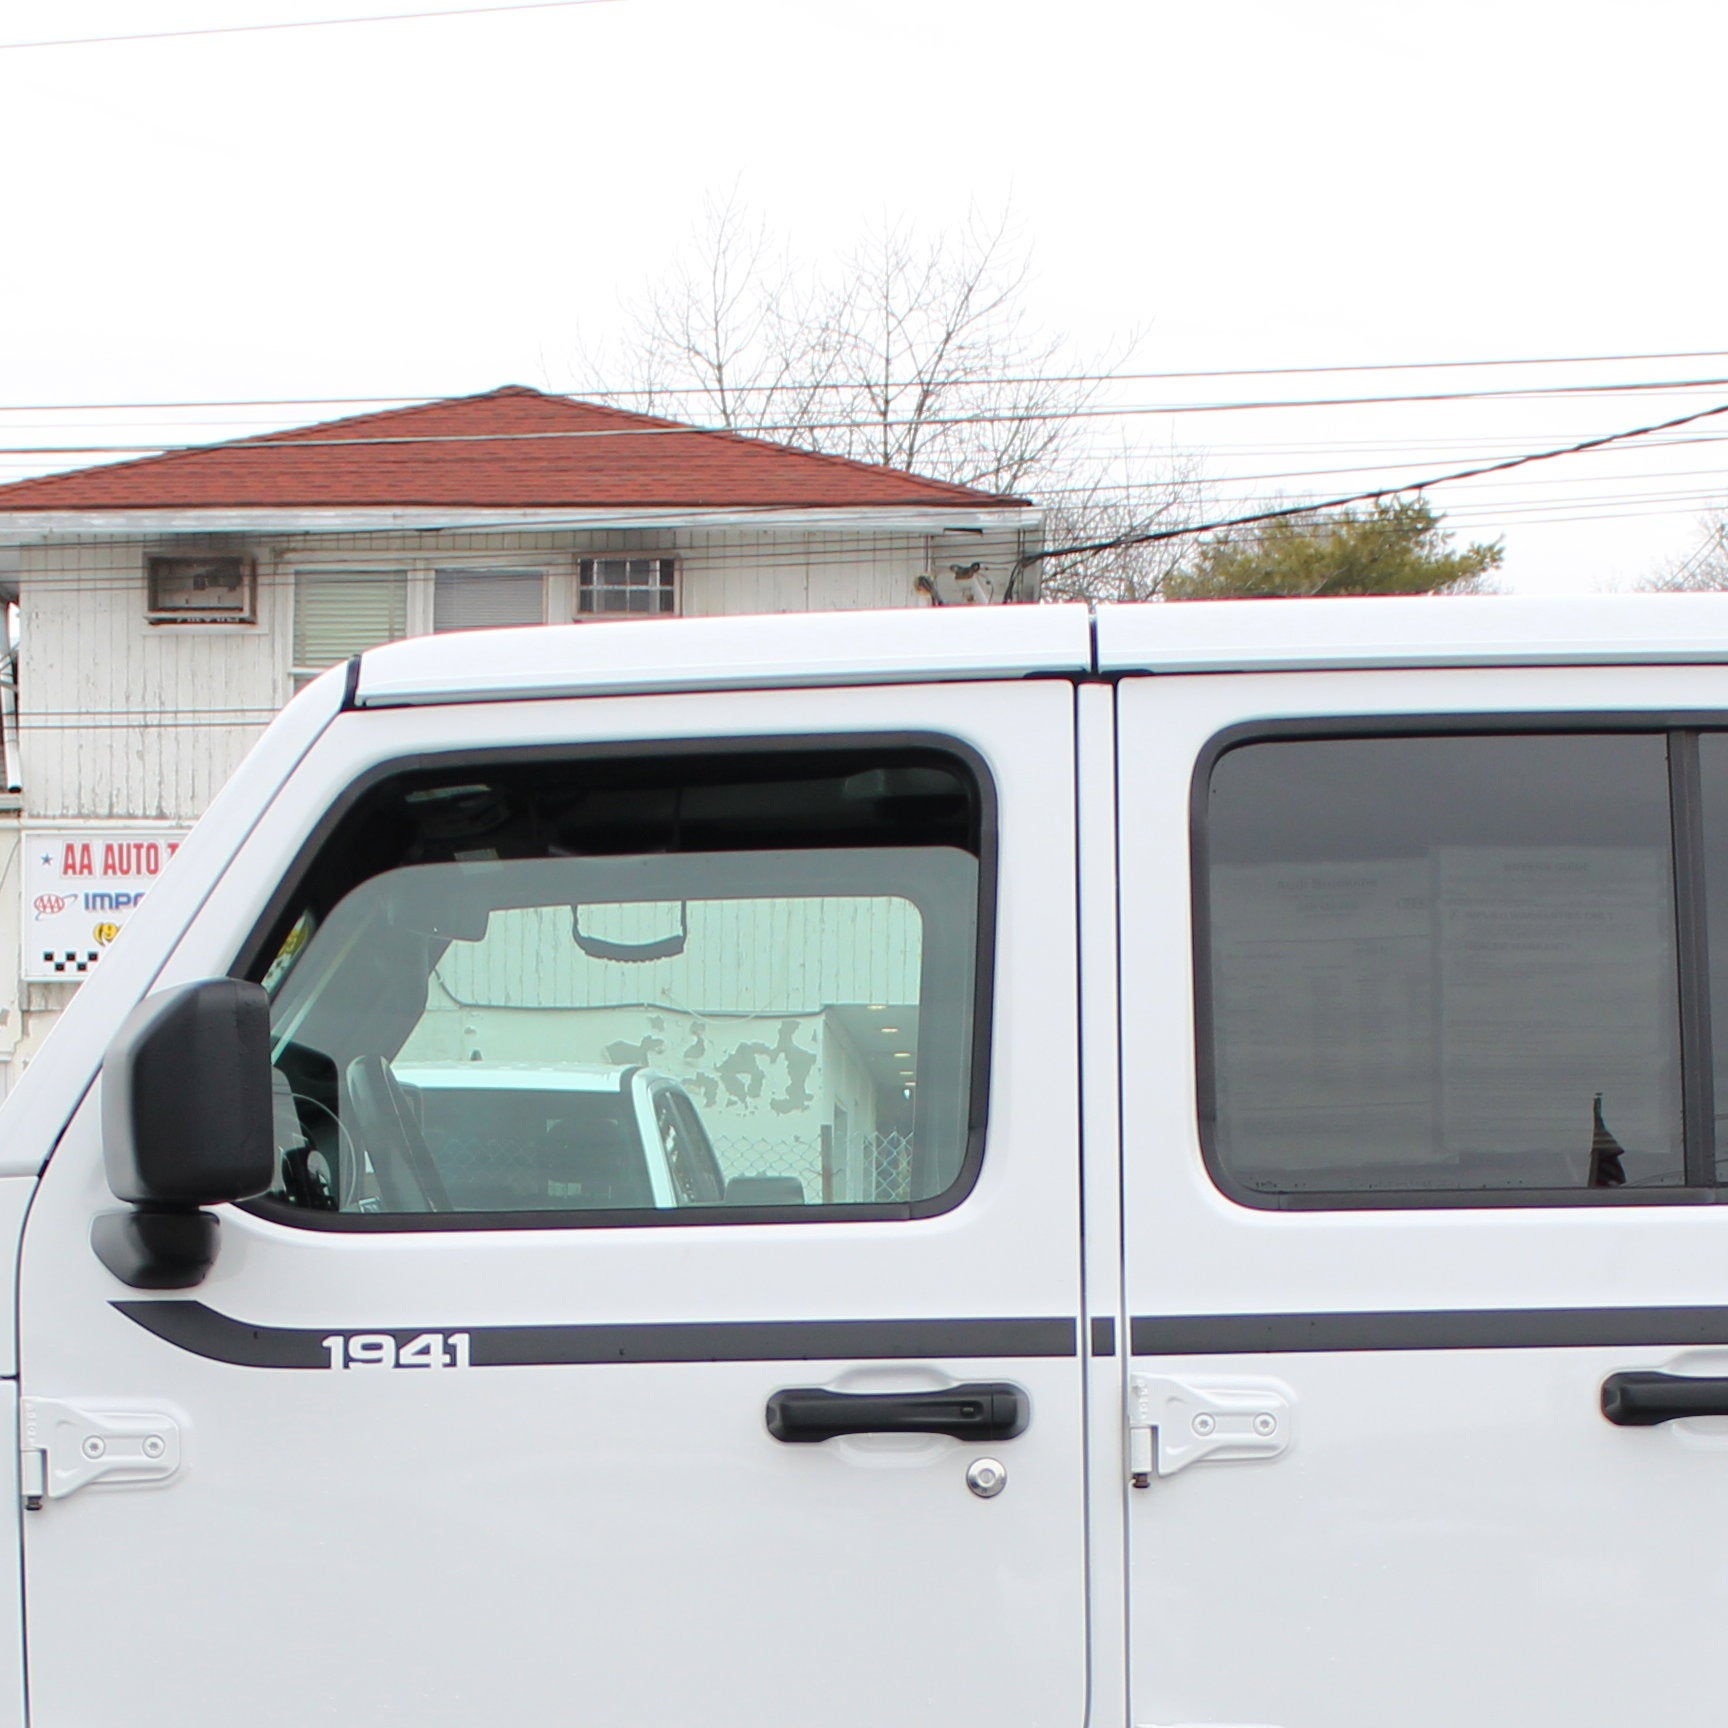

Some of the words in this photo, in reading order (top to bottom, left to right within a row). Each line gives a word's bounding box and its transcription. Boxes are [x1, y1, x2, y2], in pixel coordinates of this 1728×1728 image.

[62, 842, 94, 876] AA
[102, 842, 160, 876] AUTO
[321, 1332, 471, 1370] 1941
